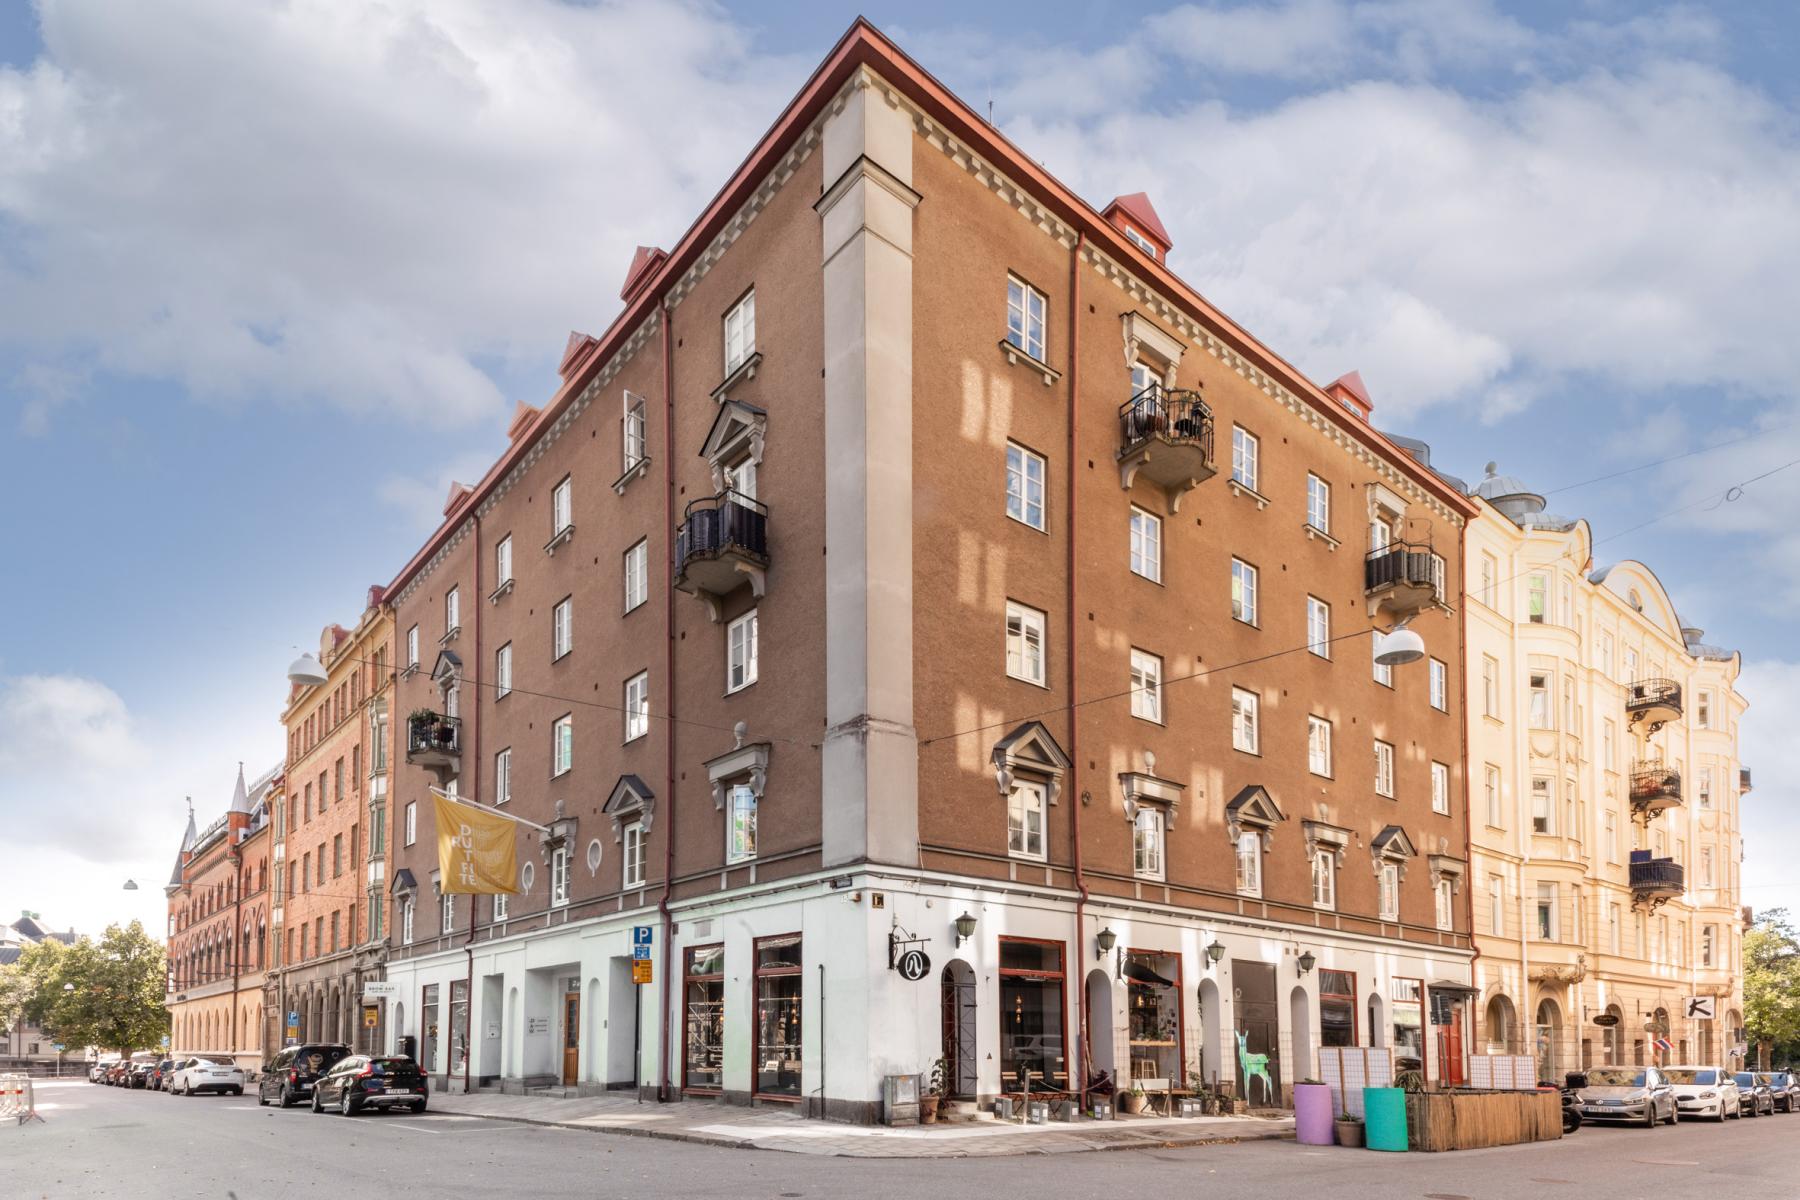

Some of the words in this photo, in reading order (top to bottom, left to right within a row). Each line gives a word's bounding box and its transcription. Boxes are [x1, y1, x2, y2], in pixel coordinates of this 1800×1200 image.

[460, 824, 472, 836] D
[464, 850, 473, 862] T
[640, 928, 649, 942] P
